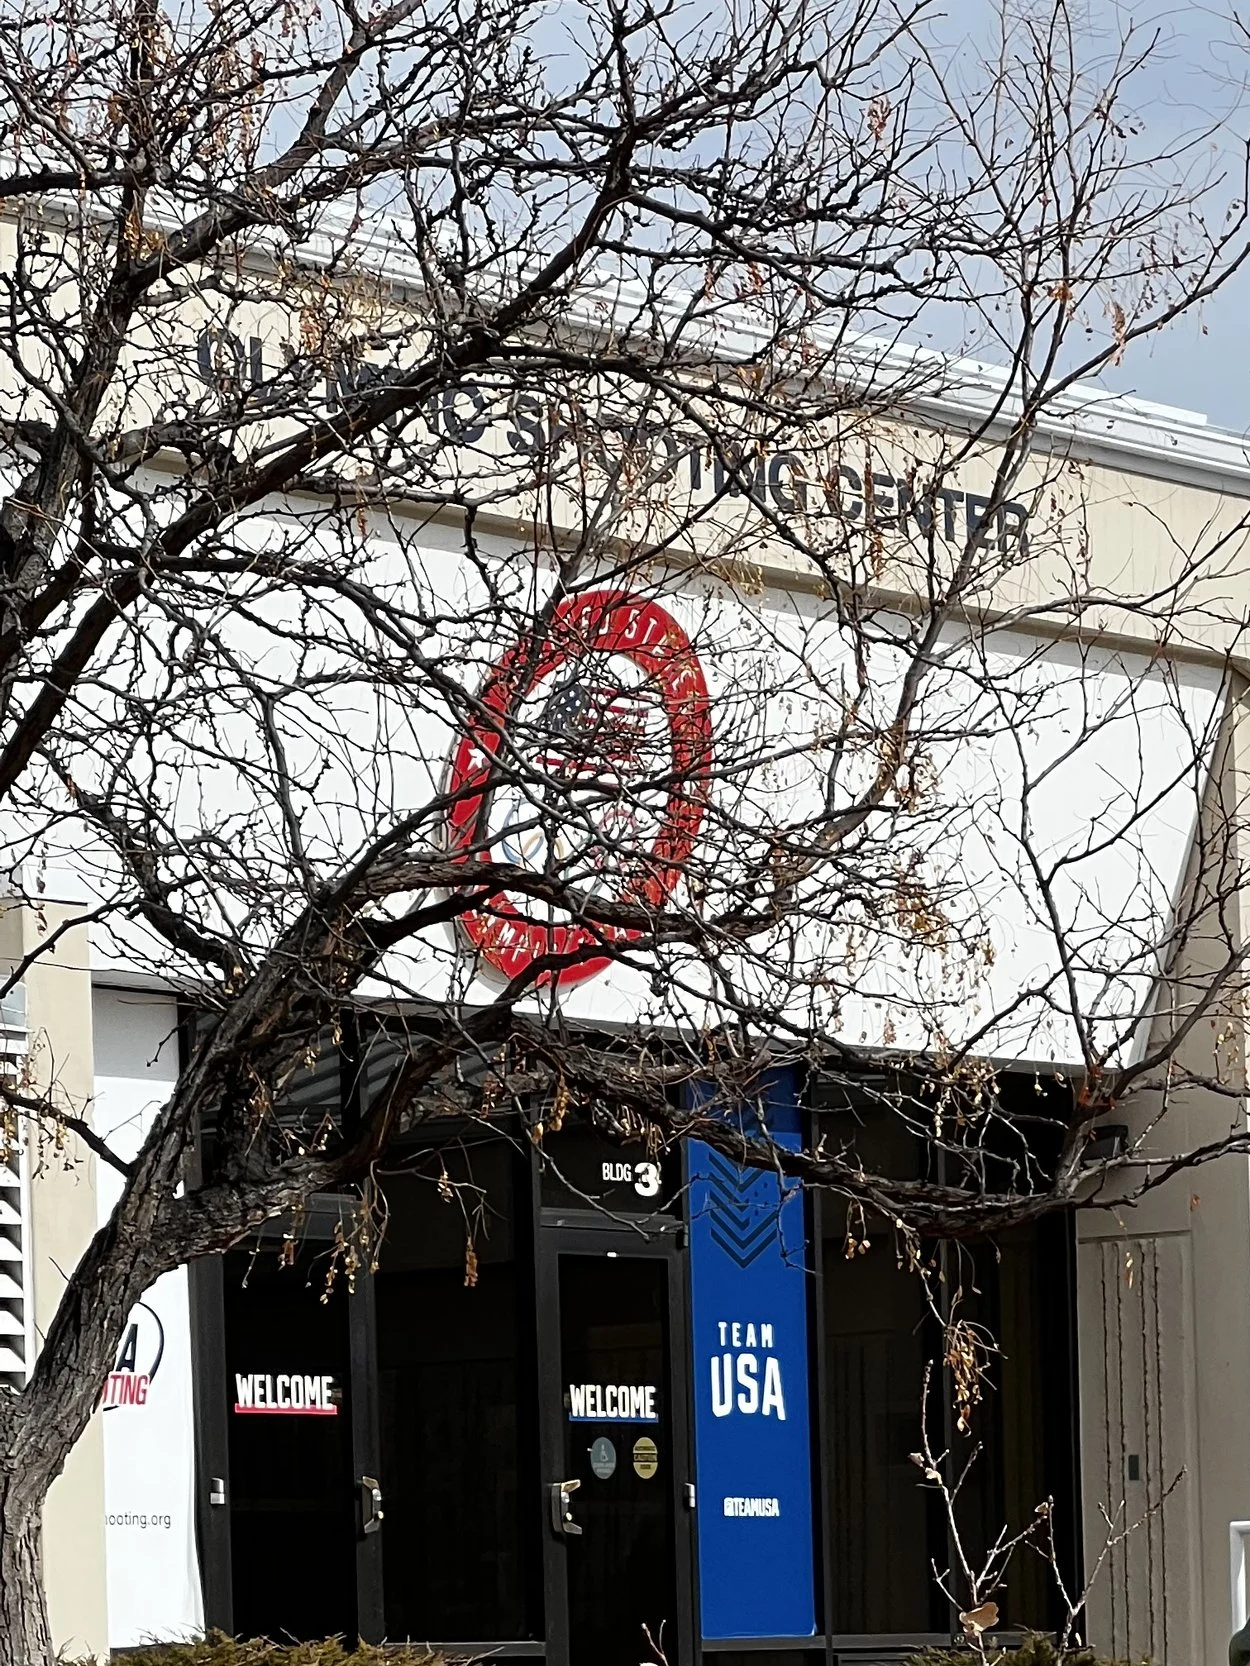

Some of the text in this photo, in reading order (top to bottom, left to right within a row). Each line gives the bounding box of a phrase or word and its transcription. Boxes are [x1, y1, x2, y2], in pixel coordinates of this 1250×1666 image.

[602, 1162, 659, 1197] BLDG 3
[718, 1321, 774, 1349] TEAM
[235, 1373, 335, 1411] WELCOME
[569, 1384, 657, 1419] WELCOME
[710, 1353, 787, 1421] USA
